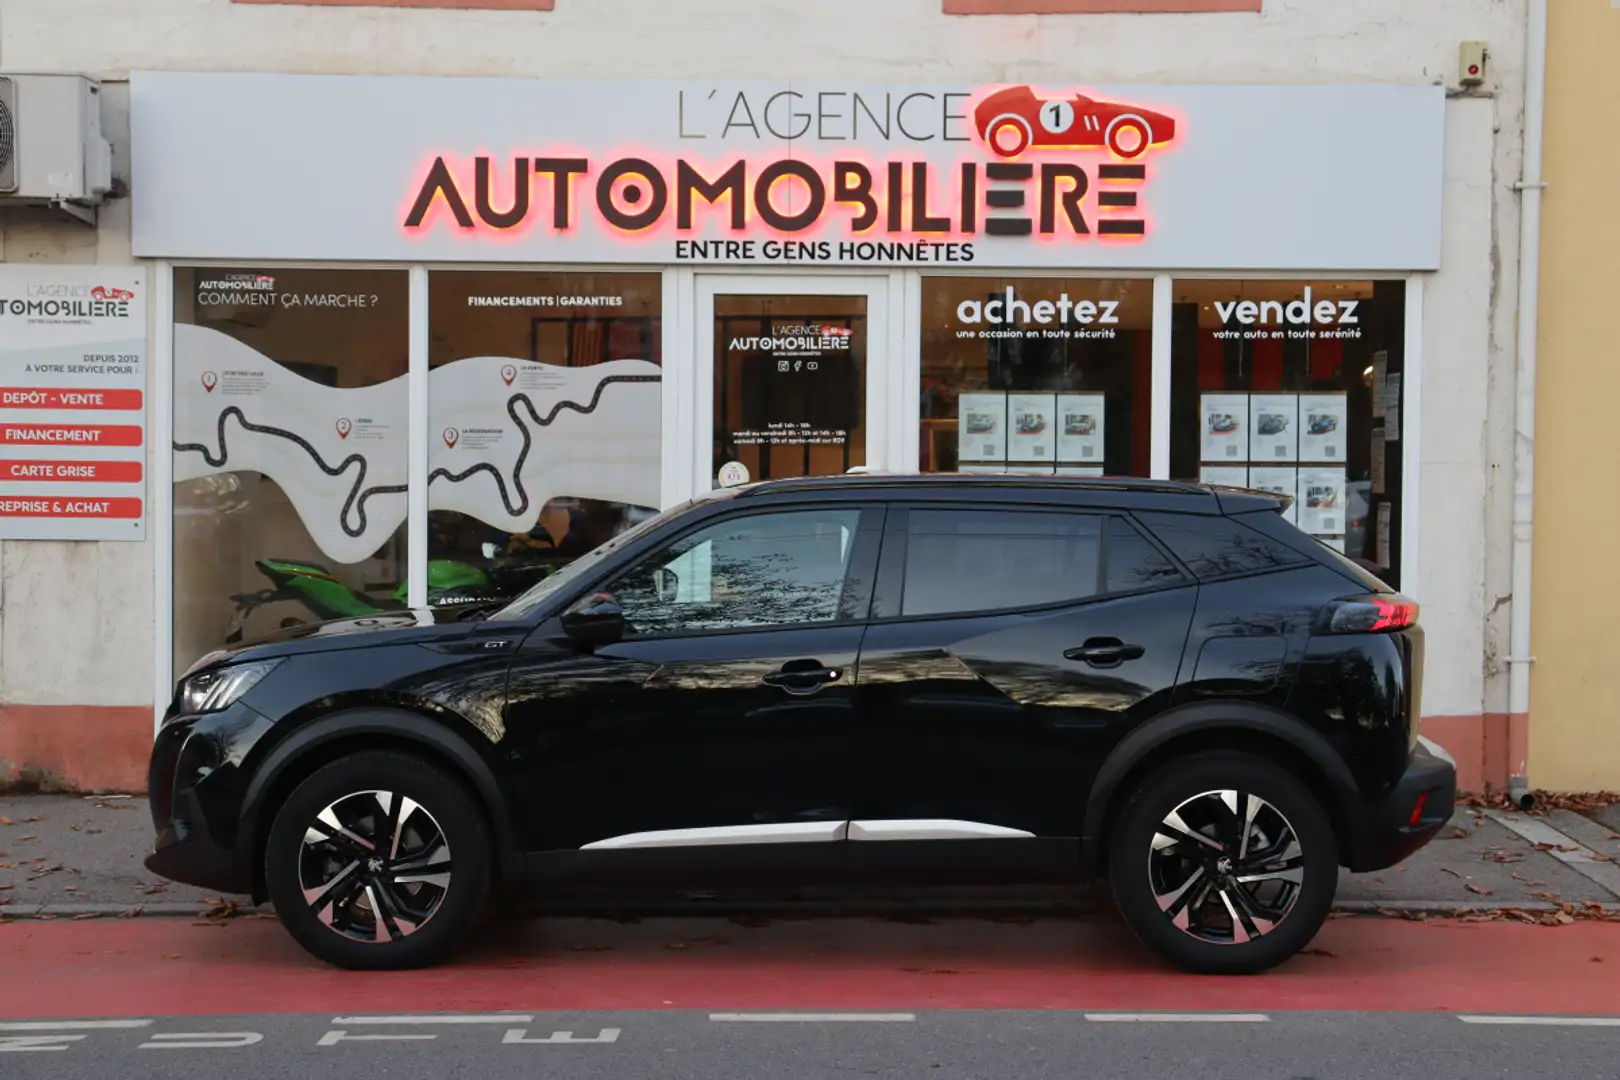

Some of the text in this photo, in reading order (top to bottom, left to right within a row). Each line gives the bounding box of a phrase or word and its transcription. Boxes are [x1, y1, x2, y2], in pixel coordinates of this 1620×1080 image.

[678, 89, 972, 142] L'AGENCE
[675, 238, 975, 262] ENTRE GENS HONNÊTES
[197, 291, 379, 309] COMMENT ÇA MARCHE ?
[468, 296, 554, 307] FINANCEMENTS
[560, 296, 623, 306] GARANTIES
[956, 286, 1120, 324] achetez
[1213, 286, 1360, 324] vendez
[956, 328, 1117, 339] une occasion en toute sécurité
[1212, 329, 1240, 339] votre
[1243, 329, 1269, 339] auto
[1271, 331, 1285, 339] en
[1287, 329, 1316, 339] toute
[83, 355, 139, 364] DEPUIS 2012
[34, 365, 65, 373] VOTRE
[67, 365, 105, 374] SERVICE
[107, 366, 133, 375] POUR
[3, 390, 47, 405] DEPÔT
[60, 392, 104, 406] VENTE
[5, 428, 101, 442] FINANCEMENT
[10, 464, 96, 477] CARTE GRISE
[52, 501, 62, 513] &
[65, 501, 110, 514] ACHAT
